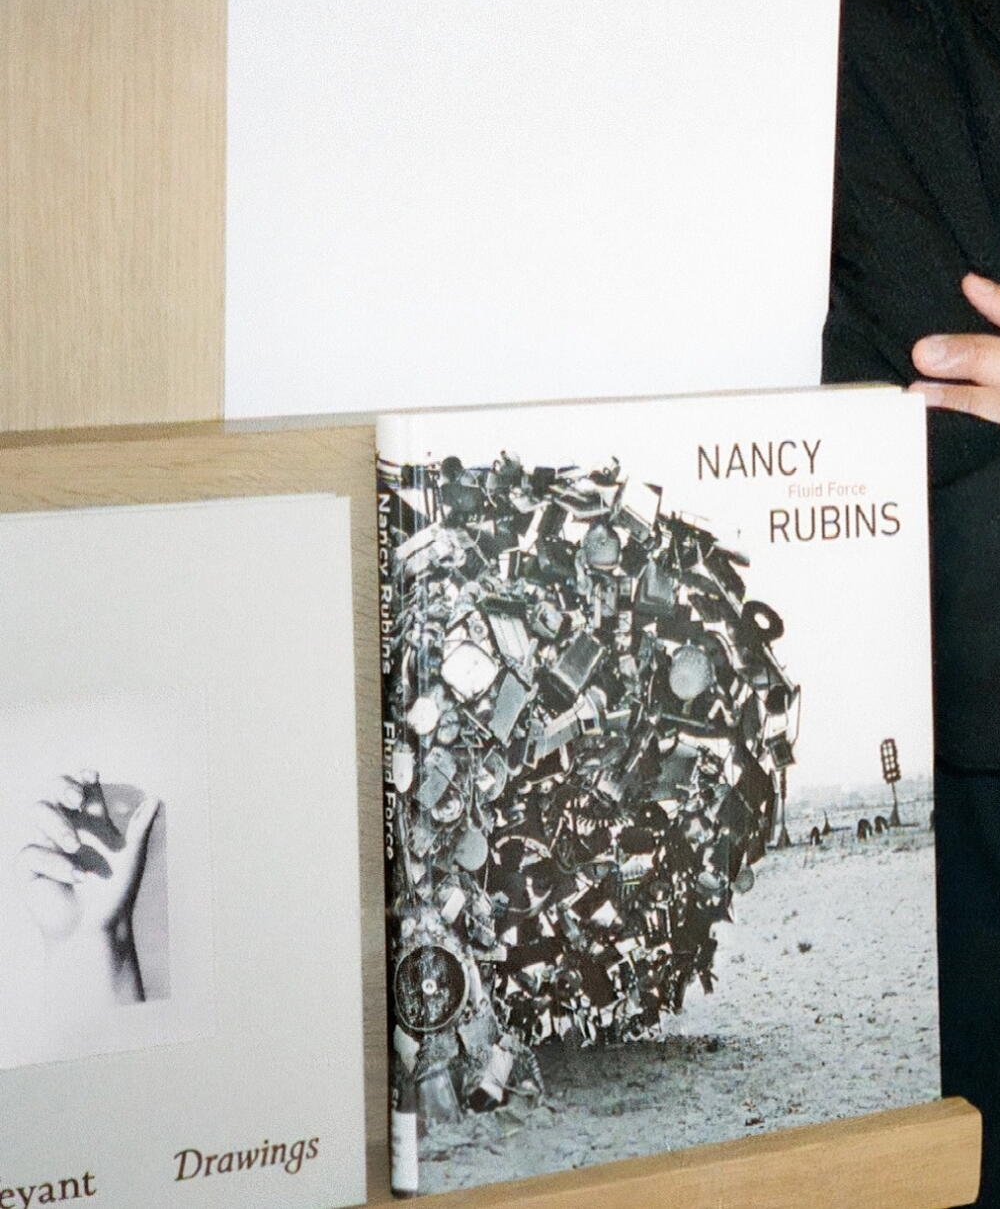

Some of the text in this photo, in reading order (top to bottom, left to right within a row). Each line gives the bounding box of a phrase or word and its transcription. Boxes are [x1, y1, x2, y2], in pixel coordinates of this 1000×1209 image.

[698, 439, 821, 480] NANCY
[788, 480, 867, 498] Fluid Force
[378, 493, 391, 577] Nancy
[770, 501, 900, 543] RUBINS
[381, 584, 394, 675] Rubins
[385, 792, 397, 860] Force
[173, 1136, 320, 1182] Drawings
[0, 1170, 96, 1209] eyant
